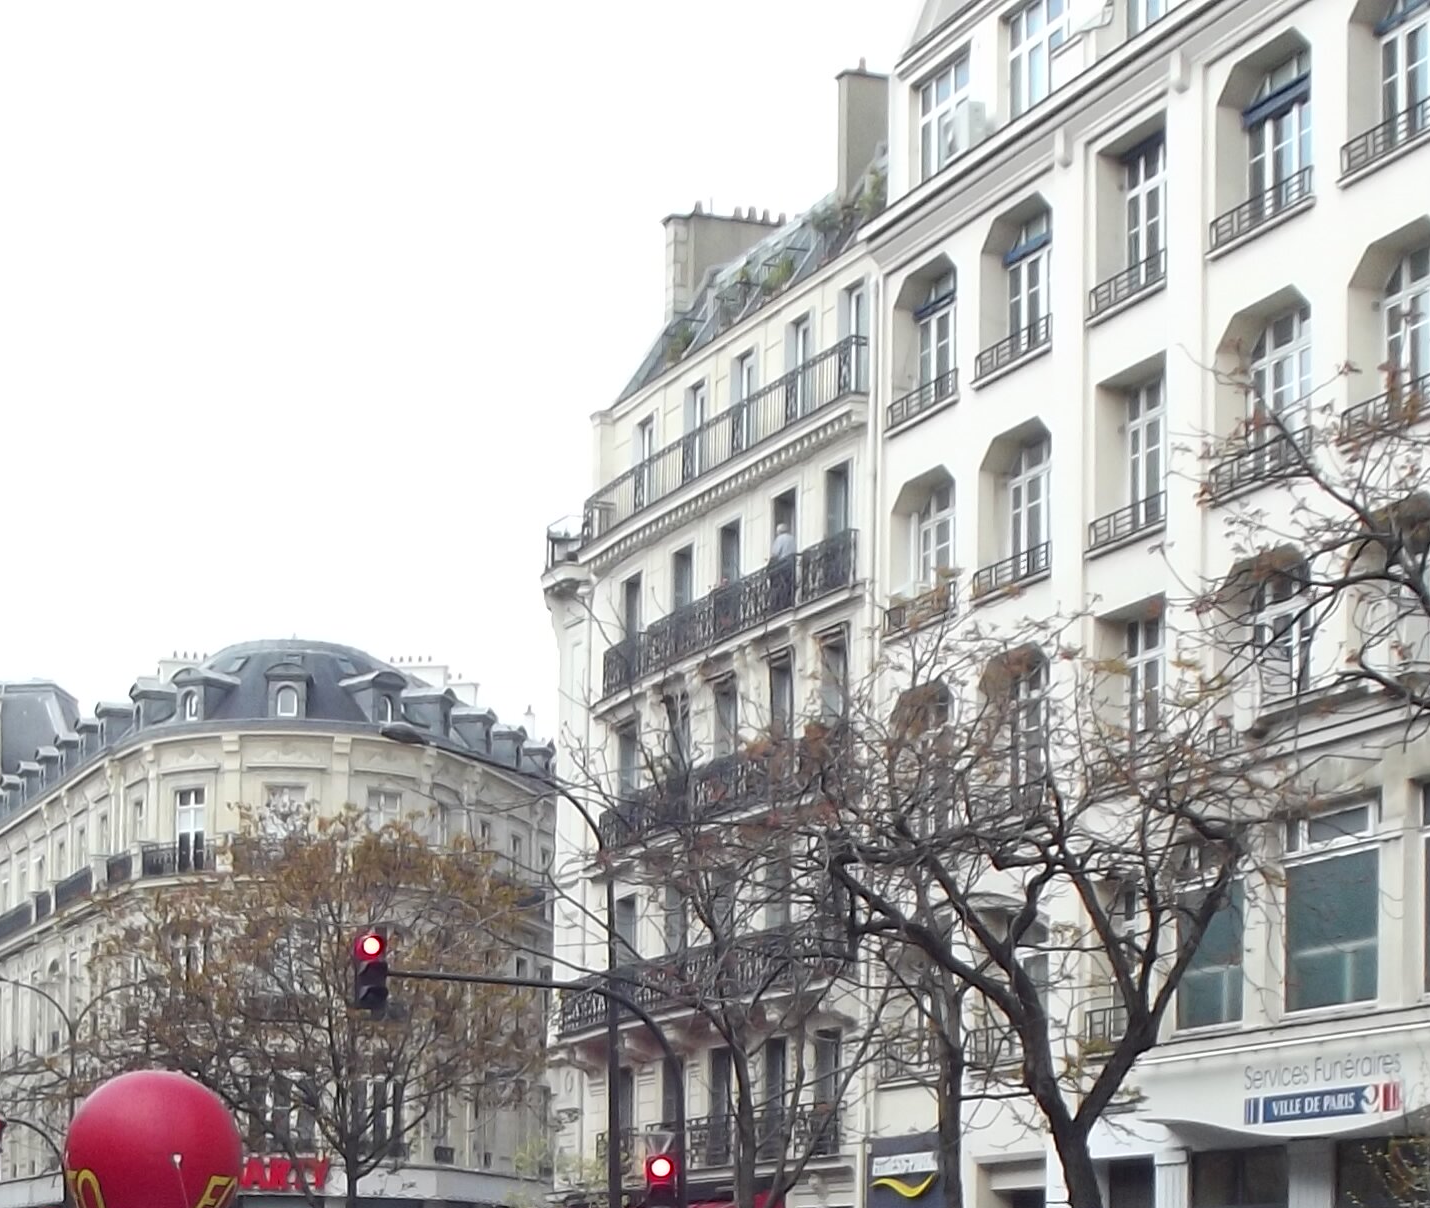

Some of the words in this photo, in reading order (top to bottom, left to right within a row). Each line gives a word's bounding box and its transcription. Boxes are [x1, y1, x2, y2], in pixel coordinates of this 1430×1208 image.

[1244, 1064, 1310, 1091] Services
[1314, 1053, 1402, 1083] Funéraires
[1272, 1096, 1301, 1117] VILLE
[1304, 1096, 1320, 1114] DE
[1323, 1092, 1356, 1112] PARIS
